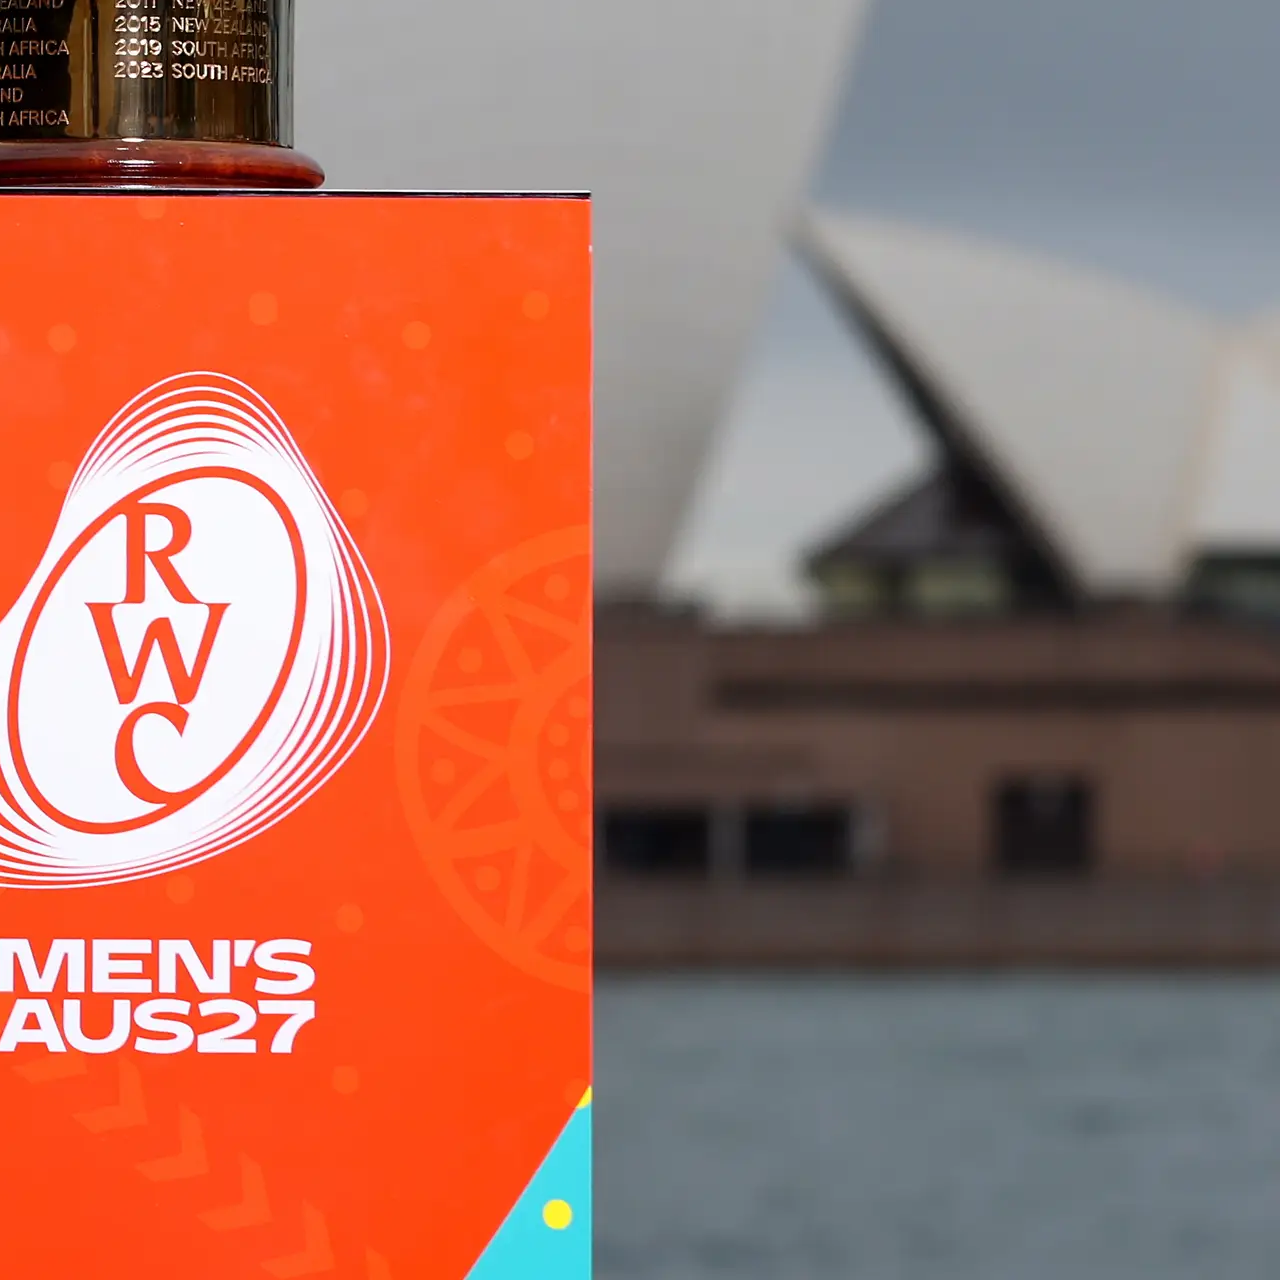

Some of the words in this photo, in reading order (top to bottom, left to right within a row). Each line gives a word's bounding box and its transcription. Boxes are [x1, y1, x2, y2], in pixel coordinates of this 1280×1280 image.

[114, 15, 161, 33] 2015
[172, 16, 209, 33] NEW
[213, 18, 268, 38] ZEALAND
[8, 39, 70, 56] AFRICA
[114, 38, 162, 56] 2019
[171, 40, 227, 58] SOUTH
[114, 61, 164, 78] 2023
[171, 62, 228, 81] SOUTH
[231, 65, 273, 85] AFRICA
[8, 109, 70, 126] AFRICA
